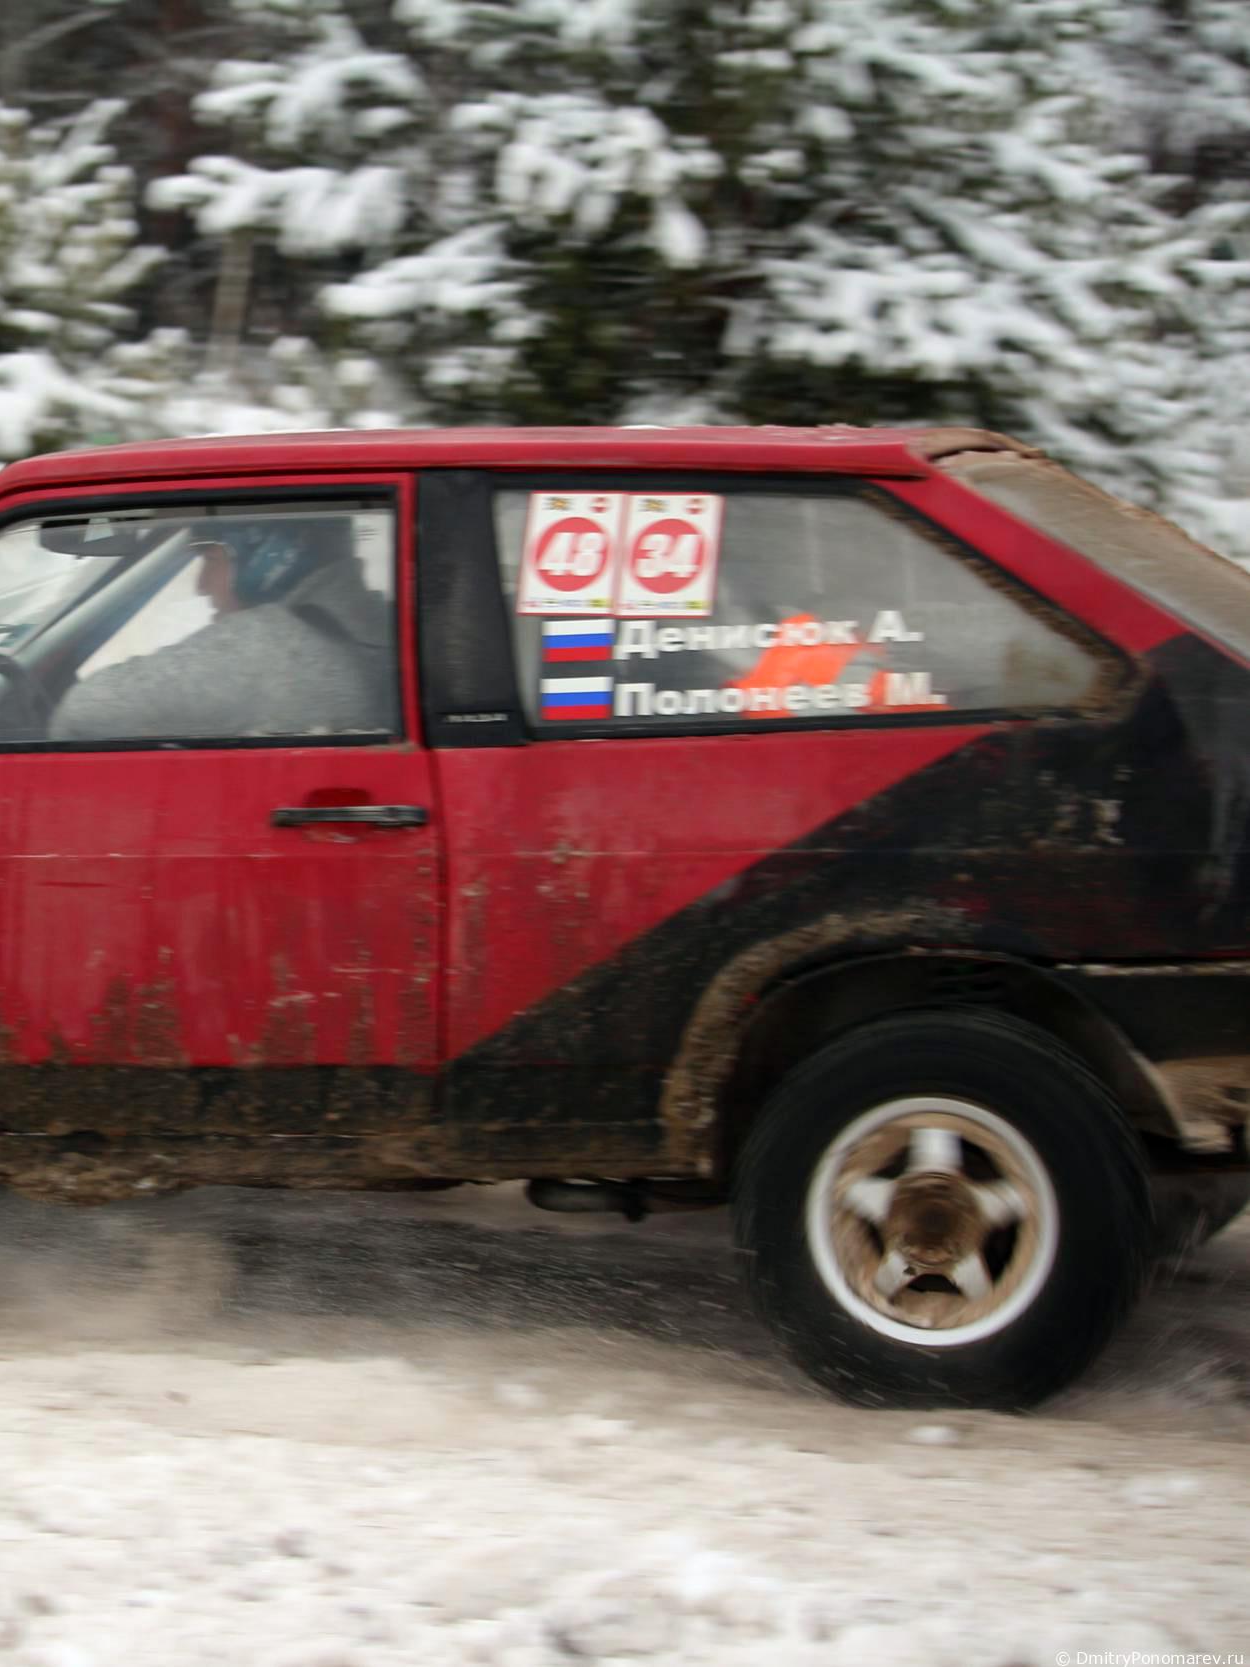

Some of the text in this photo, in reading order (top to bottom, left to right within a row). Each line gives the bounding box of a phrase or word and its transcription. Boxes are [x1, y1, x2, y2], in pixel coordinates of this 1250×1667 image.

[541, 532, 606, 576] 48
[637, 533, 703, 578] 34
[615, 610, 925, 660] Денисюк А.
[613, 672, 949, 717] Полонеев М.
